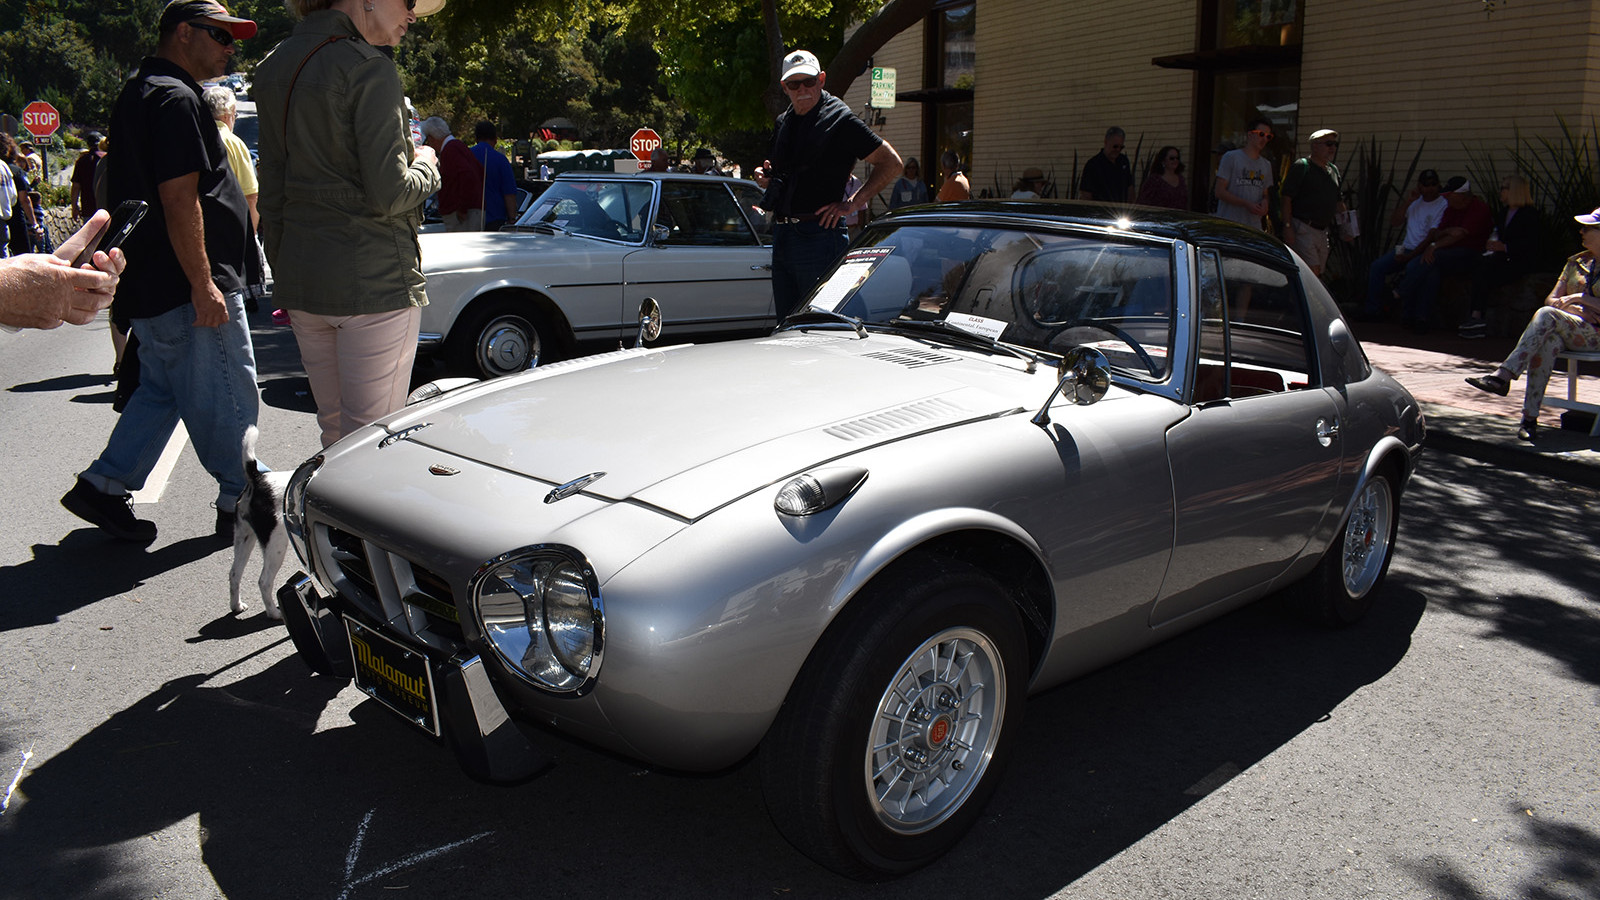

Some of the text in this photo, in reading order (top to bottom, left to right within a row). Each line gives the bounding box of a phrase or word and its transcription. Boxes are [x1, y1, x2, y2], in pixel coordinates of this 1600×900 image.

[874, 70, 881, 79] 2
[872, 81, 894, 90] PARKING
[24, 112, 57, 126] STOP
[632, 139, 660, 152] STOP
[352, 634, 426, 700] Malamut
[387, 682, 429, 713] MUSEUM
